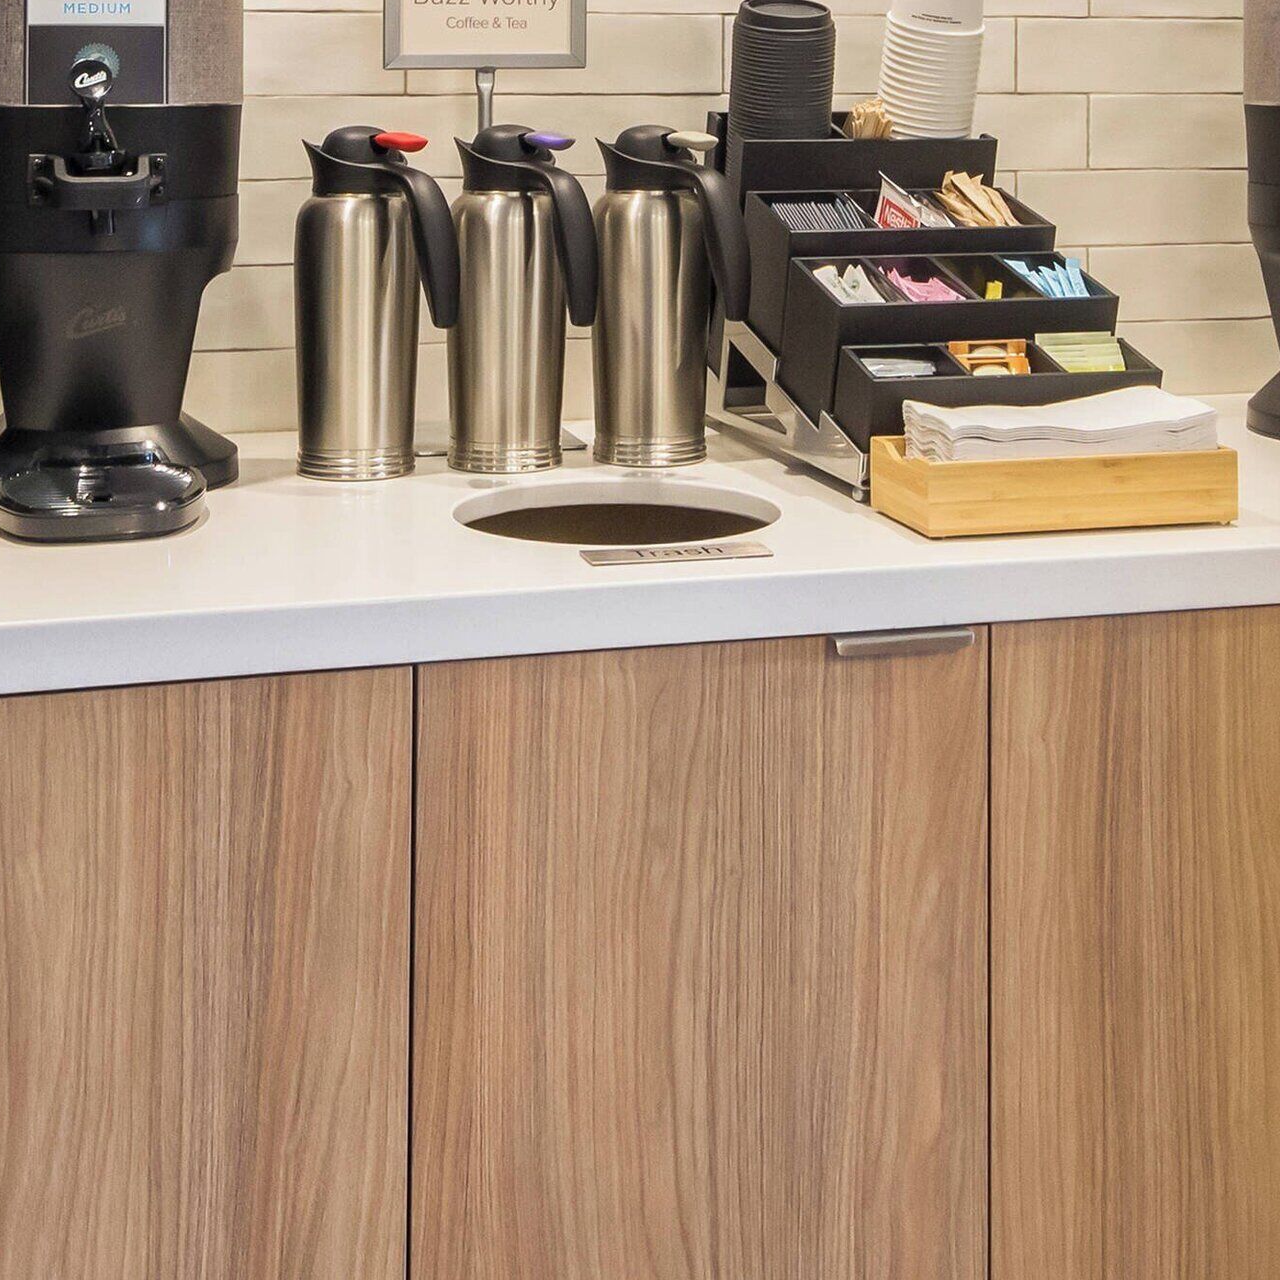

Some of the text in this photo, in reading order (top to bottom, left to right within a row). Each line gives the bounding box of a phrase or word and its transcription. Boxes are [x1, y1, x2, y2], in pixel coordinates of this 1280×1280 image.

[63, 2, 131, 15] MEDIUM
[445, 15, 528, 30] Coffee & Tea
[632, 545, 725, 558] Trash
